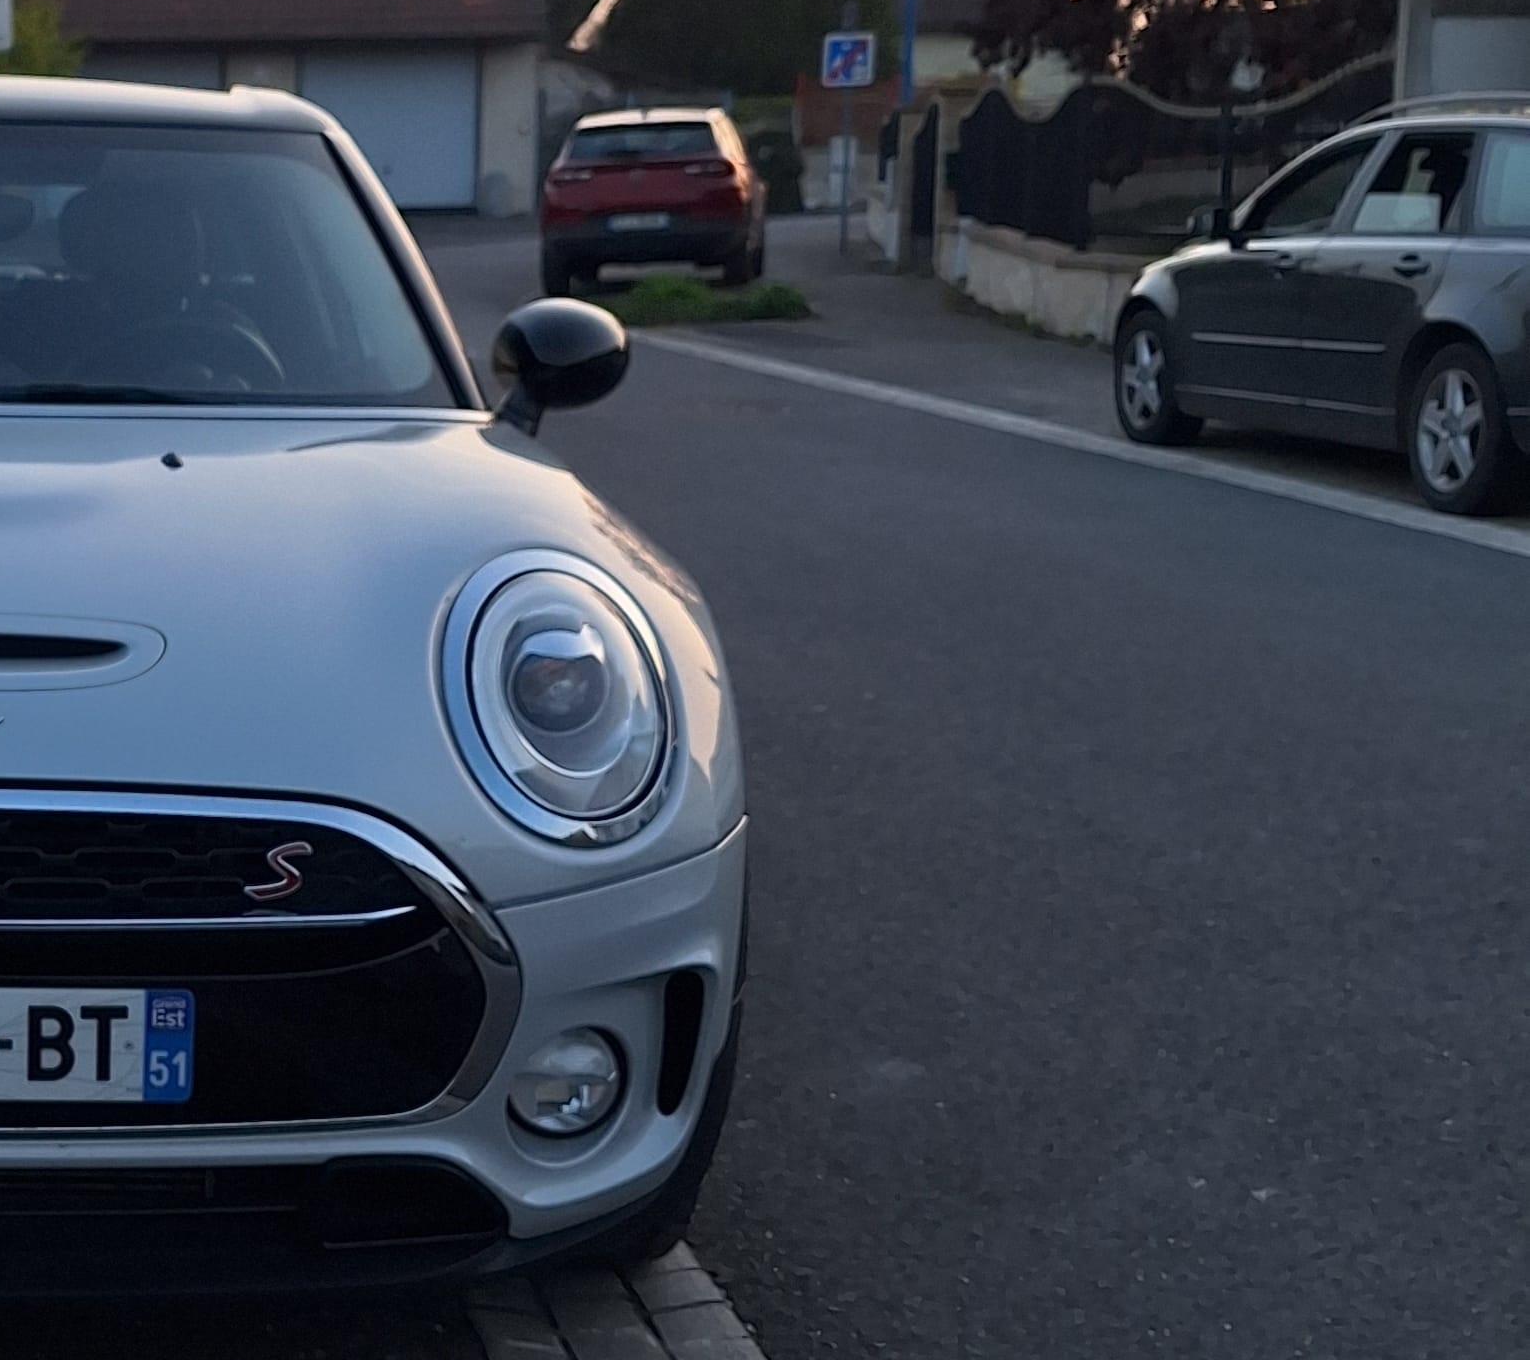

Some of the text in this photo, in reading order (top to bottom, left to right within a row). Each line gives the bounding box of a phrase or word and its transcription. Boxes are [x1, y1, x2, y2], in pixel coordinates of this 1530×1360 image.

[244, 841, 313, 901] S
[152, 1008, 185, 1028] Est
[149, 1050, 188, 1088] 51
